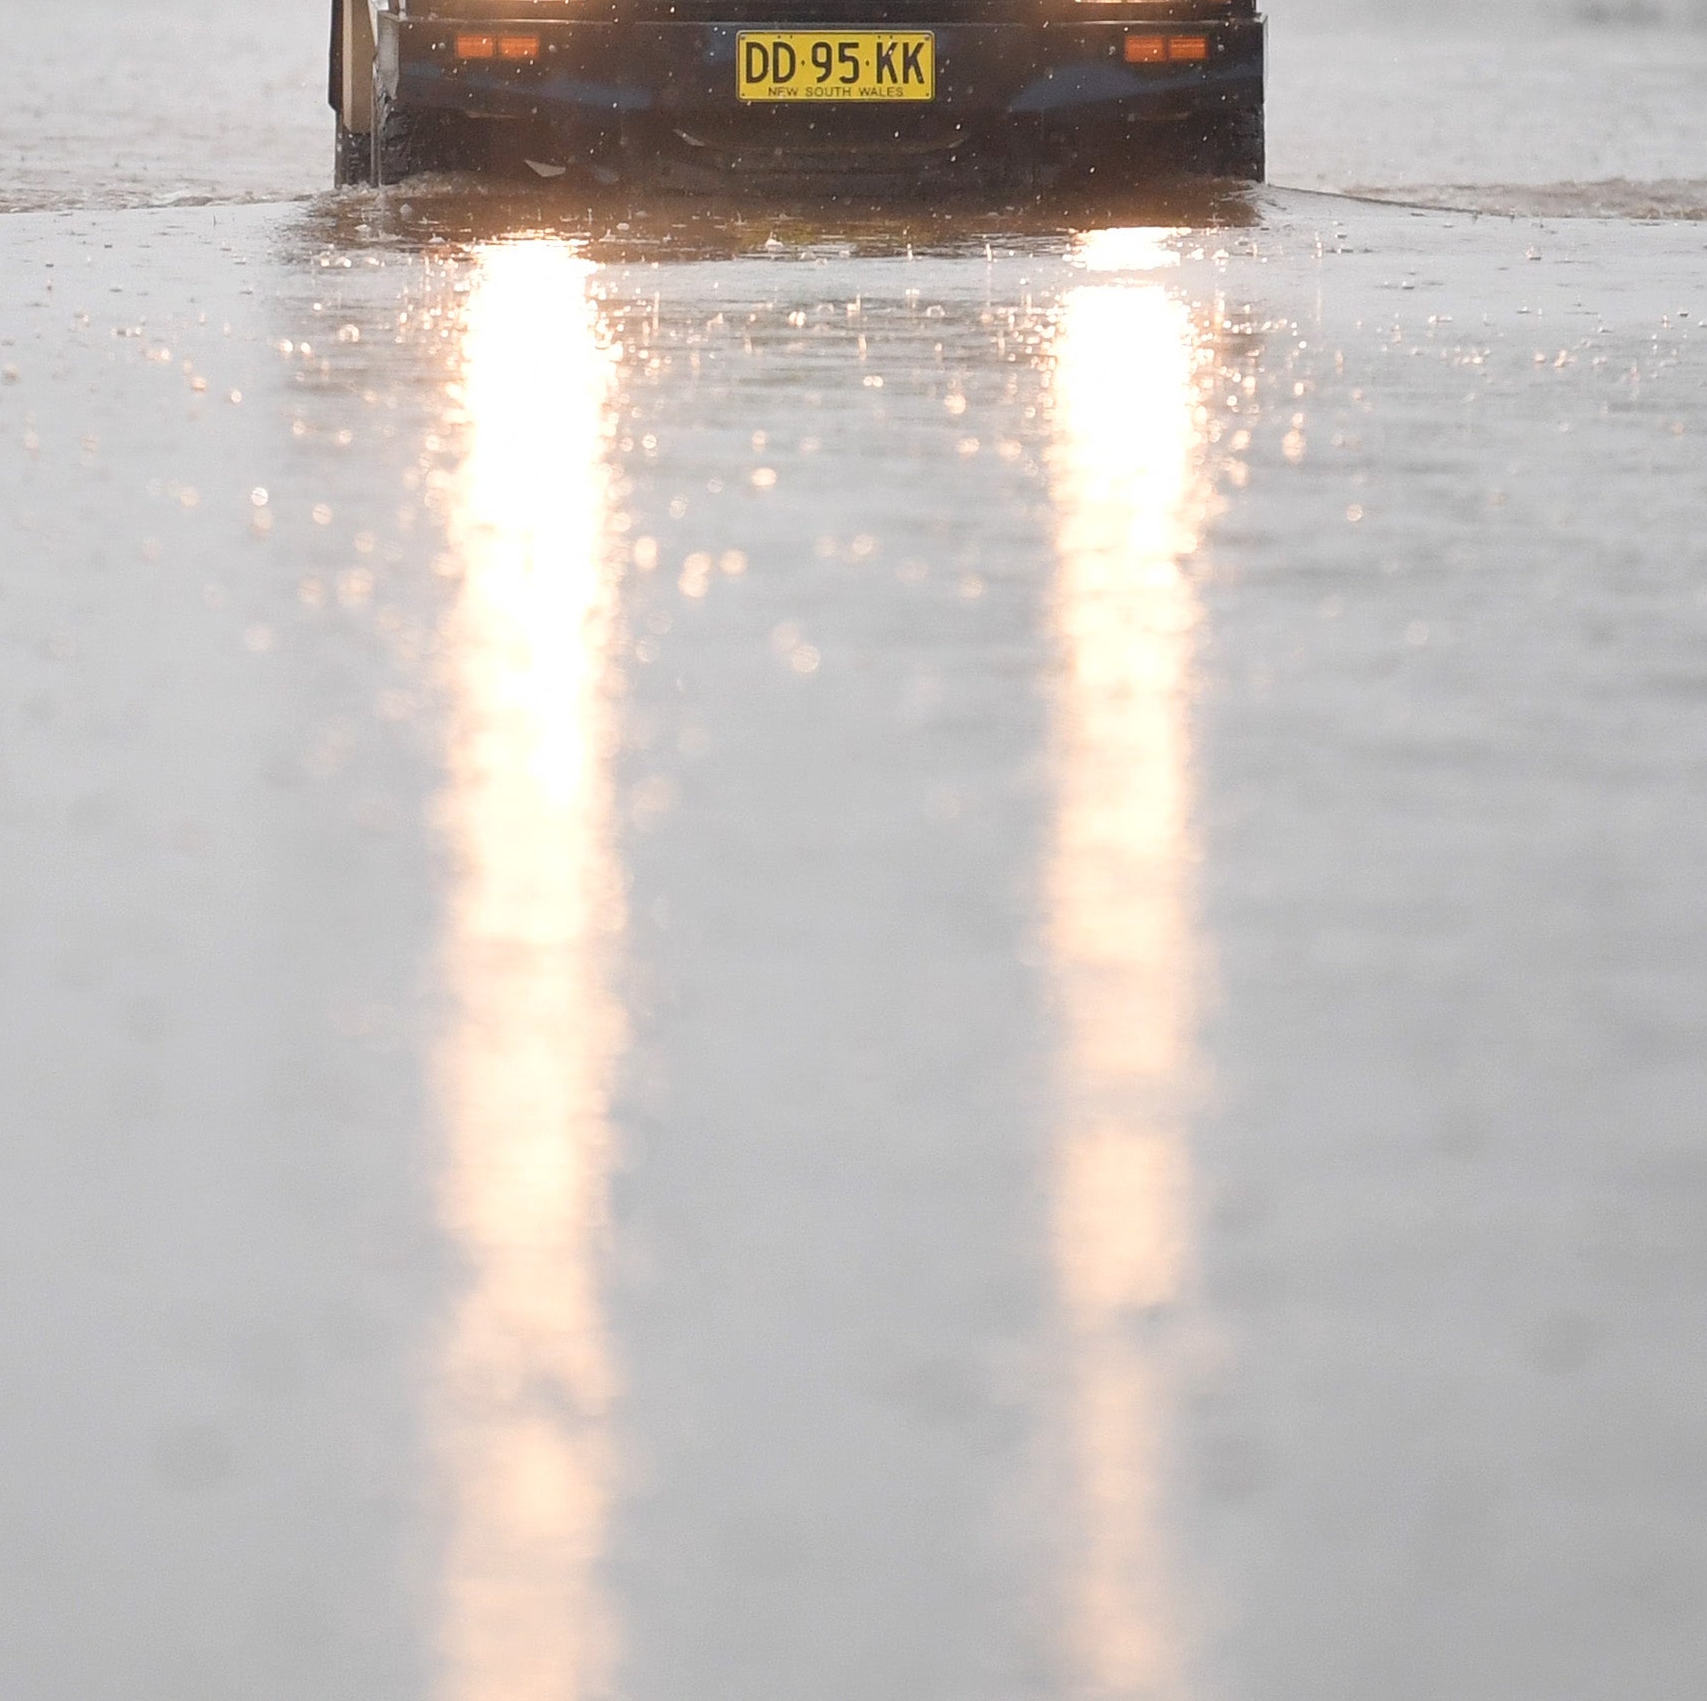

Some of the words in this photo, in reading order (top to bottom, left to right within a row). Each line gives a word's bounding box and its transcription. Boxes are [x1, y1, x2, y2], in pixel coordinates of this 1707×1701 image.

[746, 41, 796, 84] DD
[811, 41, 860, 84] 95
[876, 41, 925, 85] KK
[768, 86, 799, 97] NEW
[805, 86, 852, 97] SOUTH
[860, 86, 904, 98] WALES
